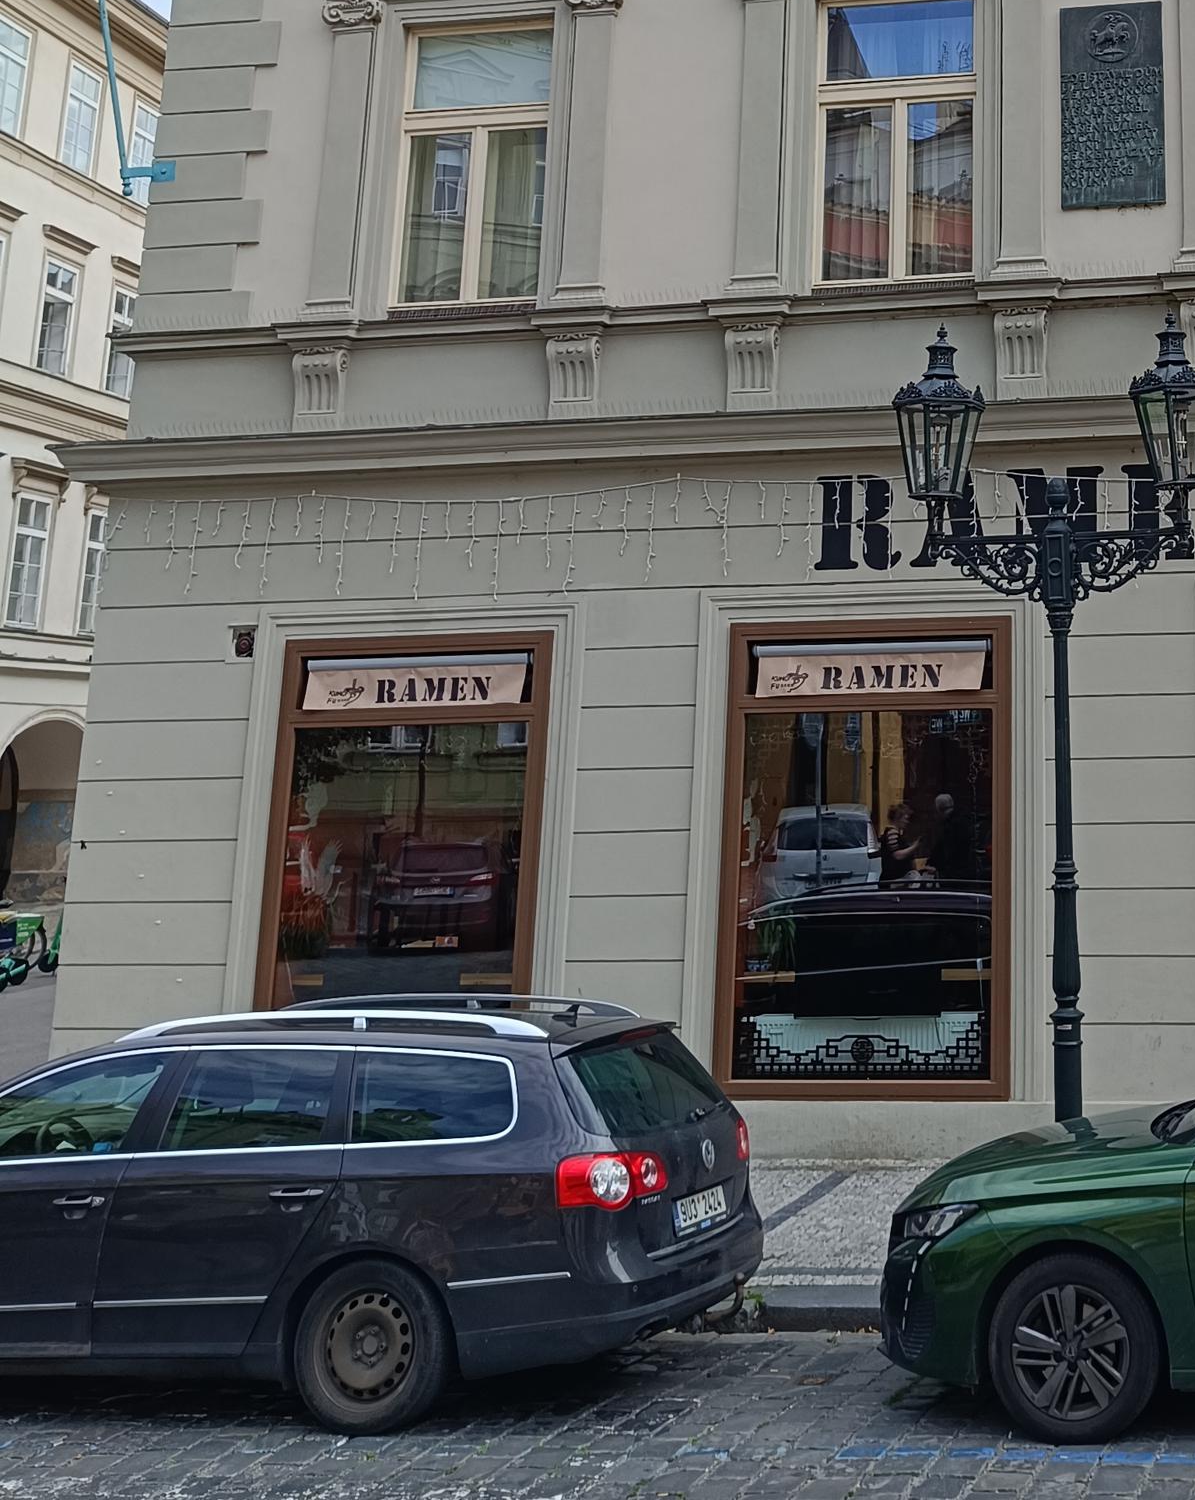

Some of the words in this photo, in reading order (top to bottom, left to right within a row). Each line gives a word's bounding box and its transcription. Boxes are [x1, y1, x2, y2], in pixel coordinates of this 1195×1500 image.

[374, 676, 493, 704] RAMEN
[820, 663, 944, 690] RAMEN
[680, 1198, 698, 1223] 9U3
[702, 1188, 722, 1216] 2424
